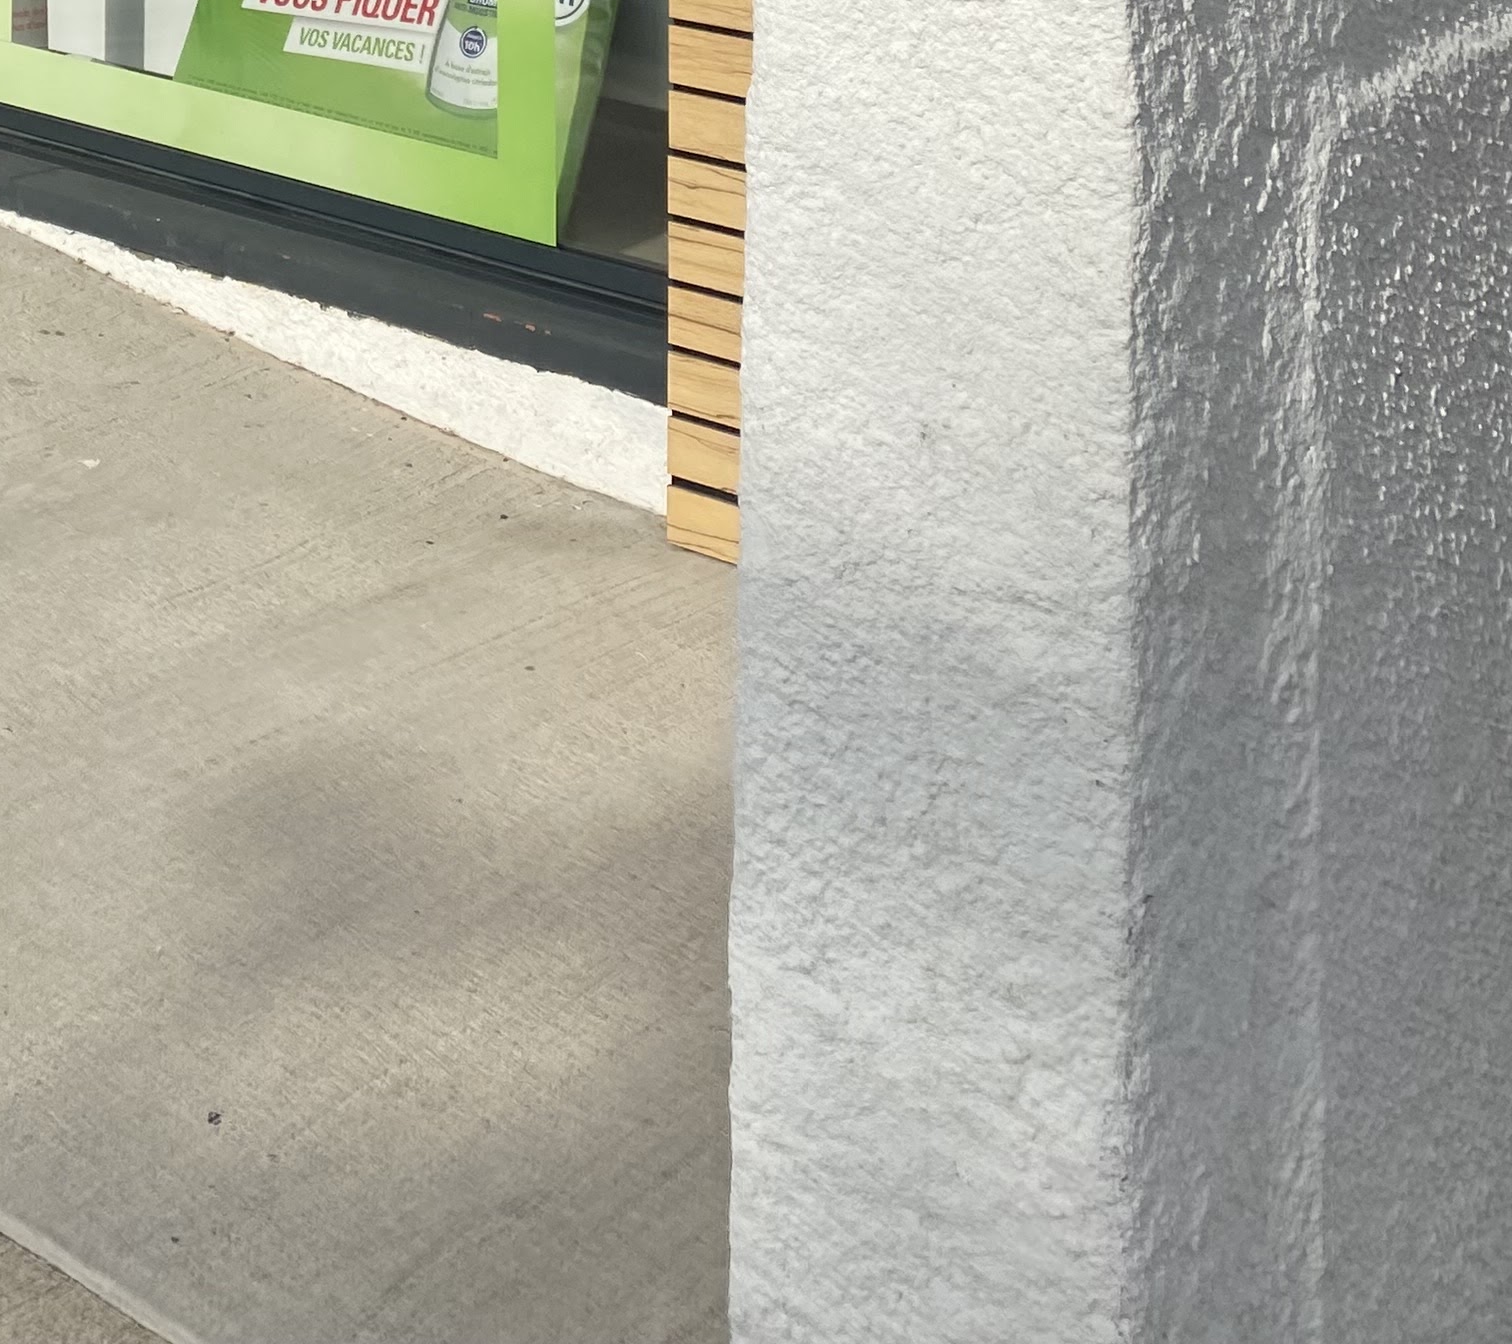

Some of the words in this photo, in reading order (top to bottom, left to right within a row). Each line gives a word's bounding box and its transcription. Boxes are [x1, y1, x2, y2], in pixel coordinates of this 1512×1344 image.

[299, 26, 330, 48] VOS
[332, 31, 416, 62] VACANCES
[419, 43, 426, 64] !
